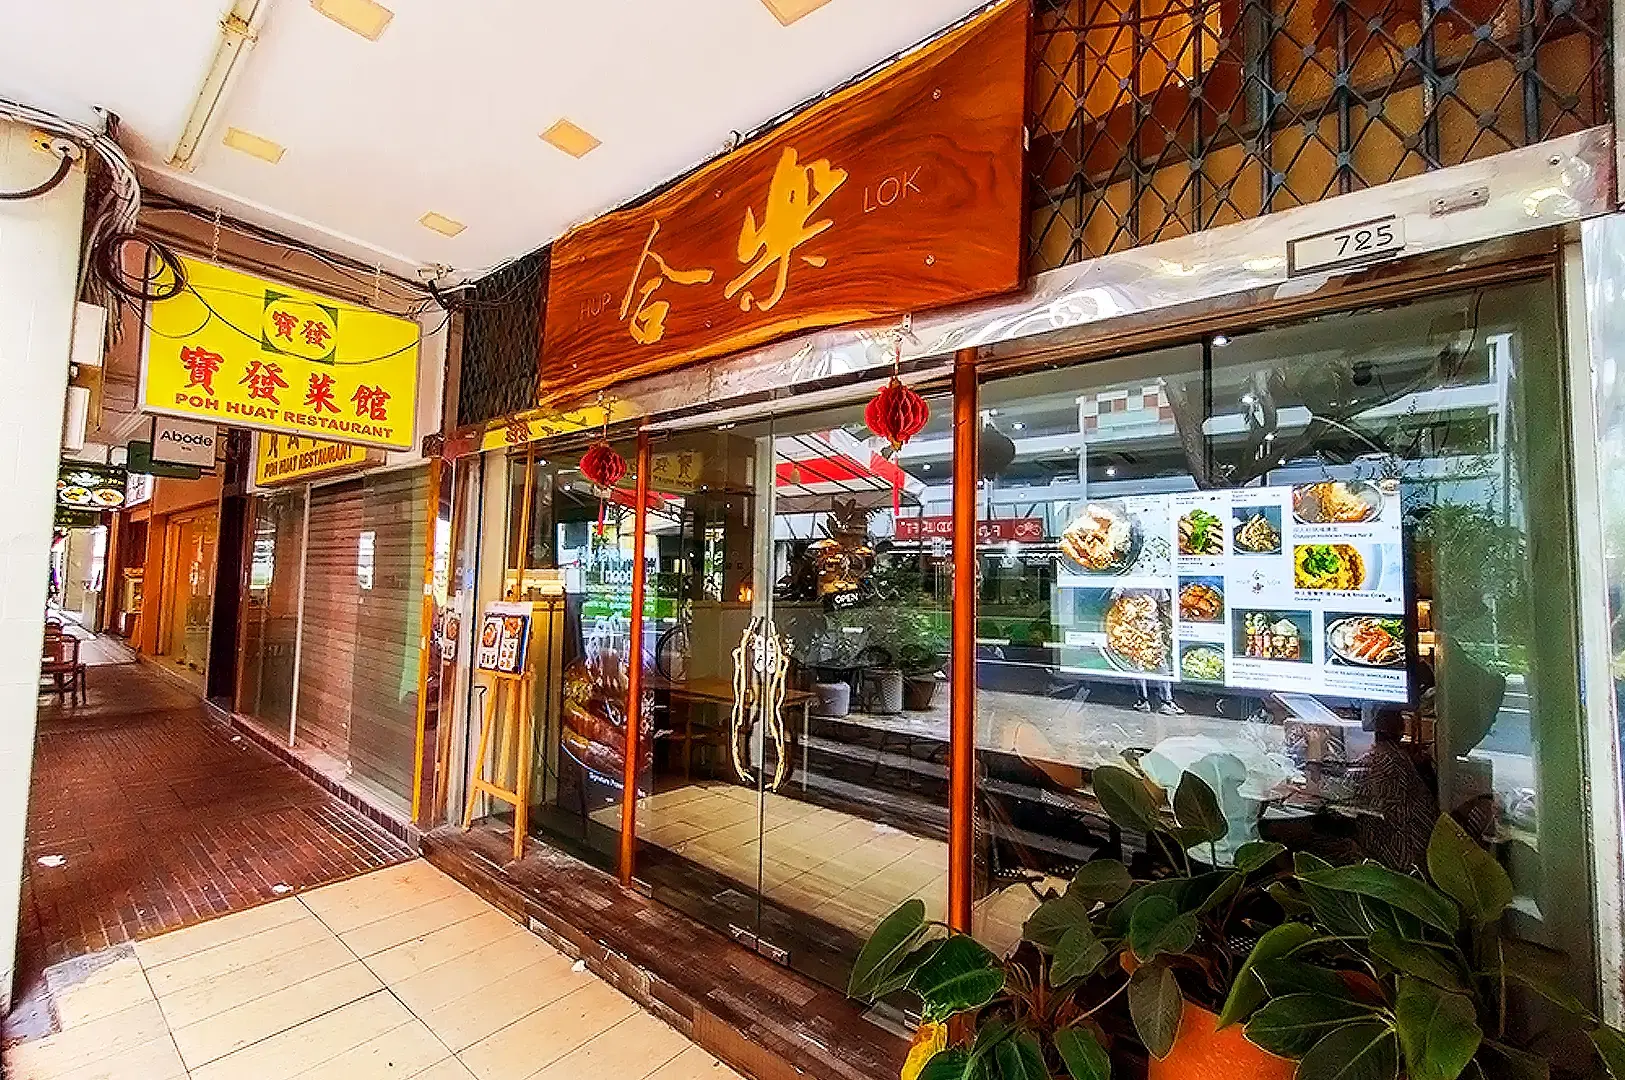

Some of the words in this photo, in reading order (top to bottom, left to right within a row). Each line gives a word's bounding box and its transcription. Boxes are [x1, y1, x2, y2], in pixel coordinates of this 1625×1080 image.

[580, 292, 612, 318] HUP
[864, 166, 921, 212] LOK
[1334, 224, 1393, 256] 725
[271, 310, 332, 350] 寶發
[180, 346, 392, 421] 寶發菜館
[175, 393, 219, 410] POH
[226, 401, 279, 419] HUAT
[283, 410, 394, 438] RESTAURANT
[160, 430, 213, 447] Abode
[264, 461, 278, 479] POH
[300, 442, 352, 470] RESTAURANT
